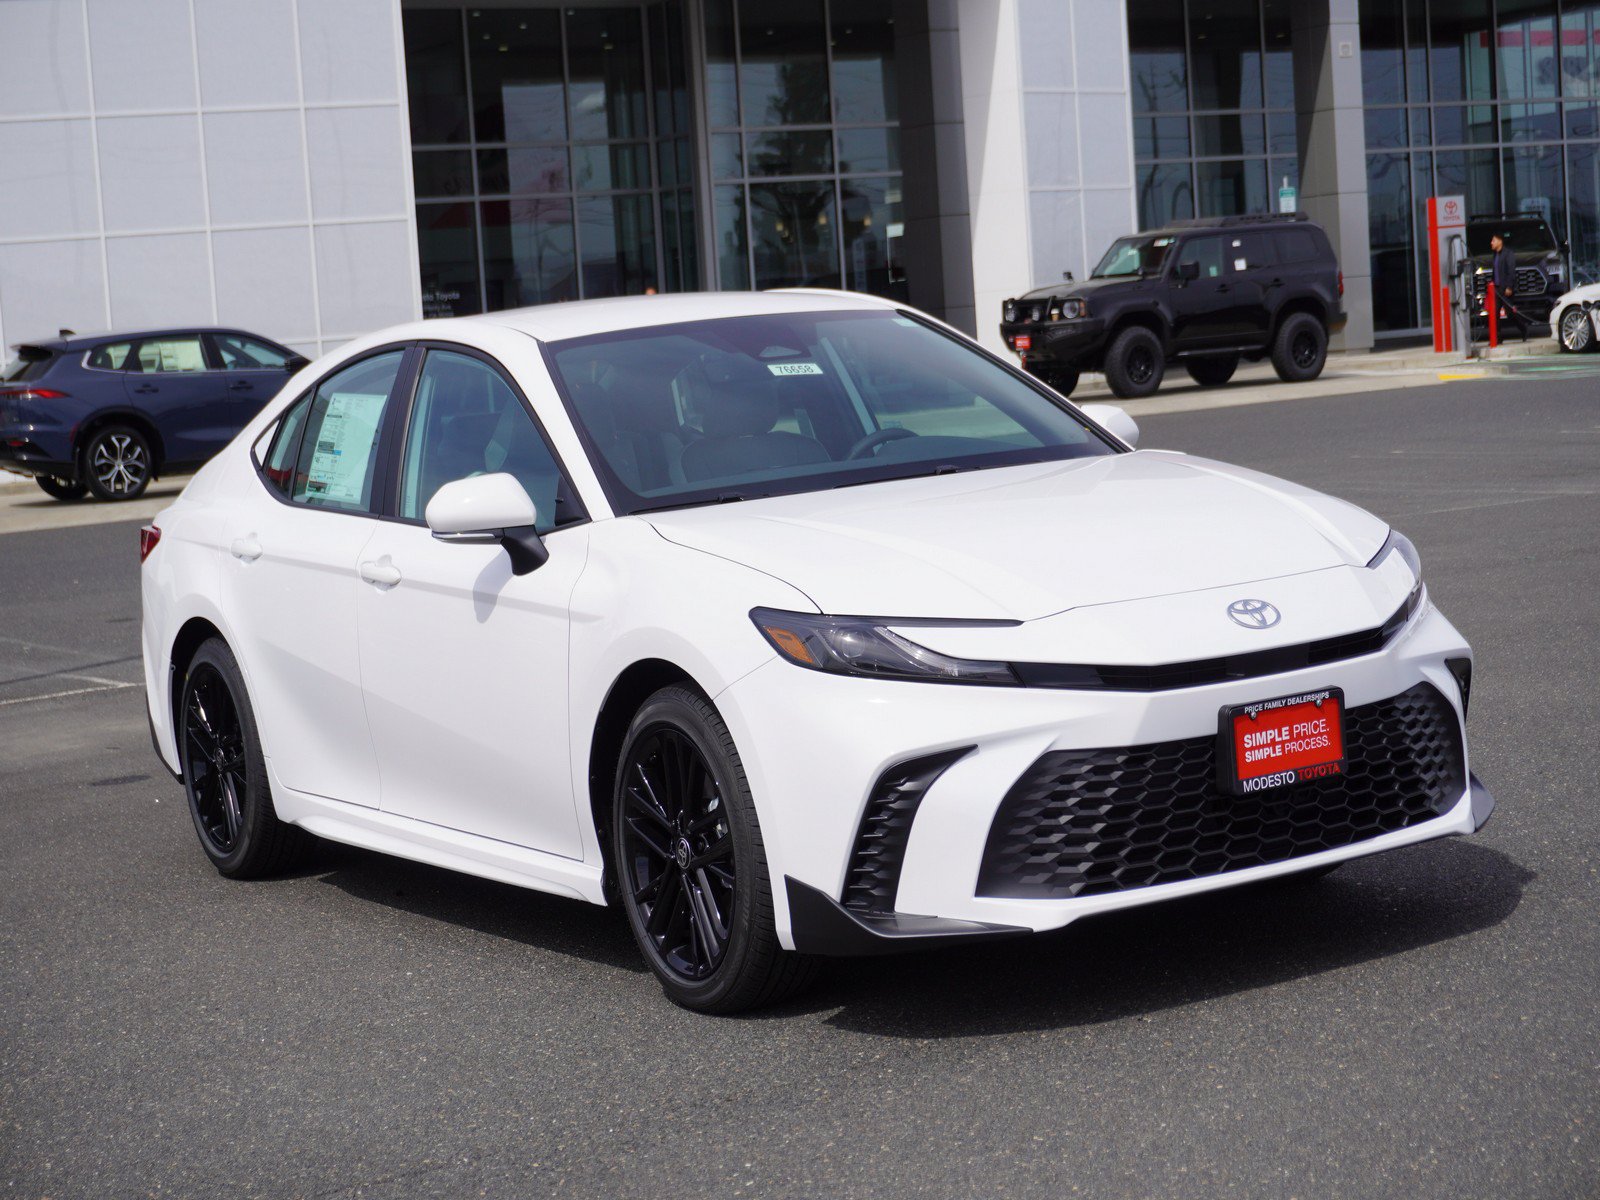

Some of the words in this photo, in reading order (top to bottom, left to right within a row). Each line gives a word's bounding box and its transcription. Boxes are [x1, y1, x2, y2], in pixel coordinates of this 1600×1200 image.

[775, 365, 814, 374] 76658
[1244, 705, 1263, 714] PRICE
[1264, 699, 1287, 710] FAMILY
[1287, 692, 1329, 704] DEALERSHIPS
[1243, 727, 1289, 748] SIMPLE
[1293, 718, 1330, 738] PRICE.
[1245, 745, 1282, 763] SIMPLE
[1285, 735, 1331, 755] PROCESS.
[1243, 771, 1295, 793] MODESTO
[1298, 763, 1341, 781] TOYOTA
